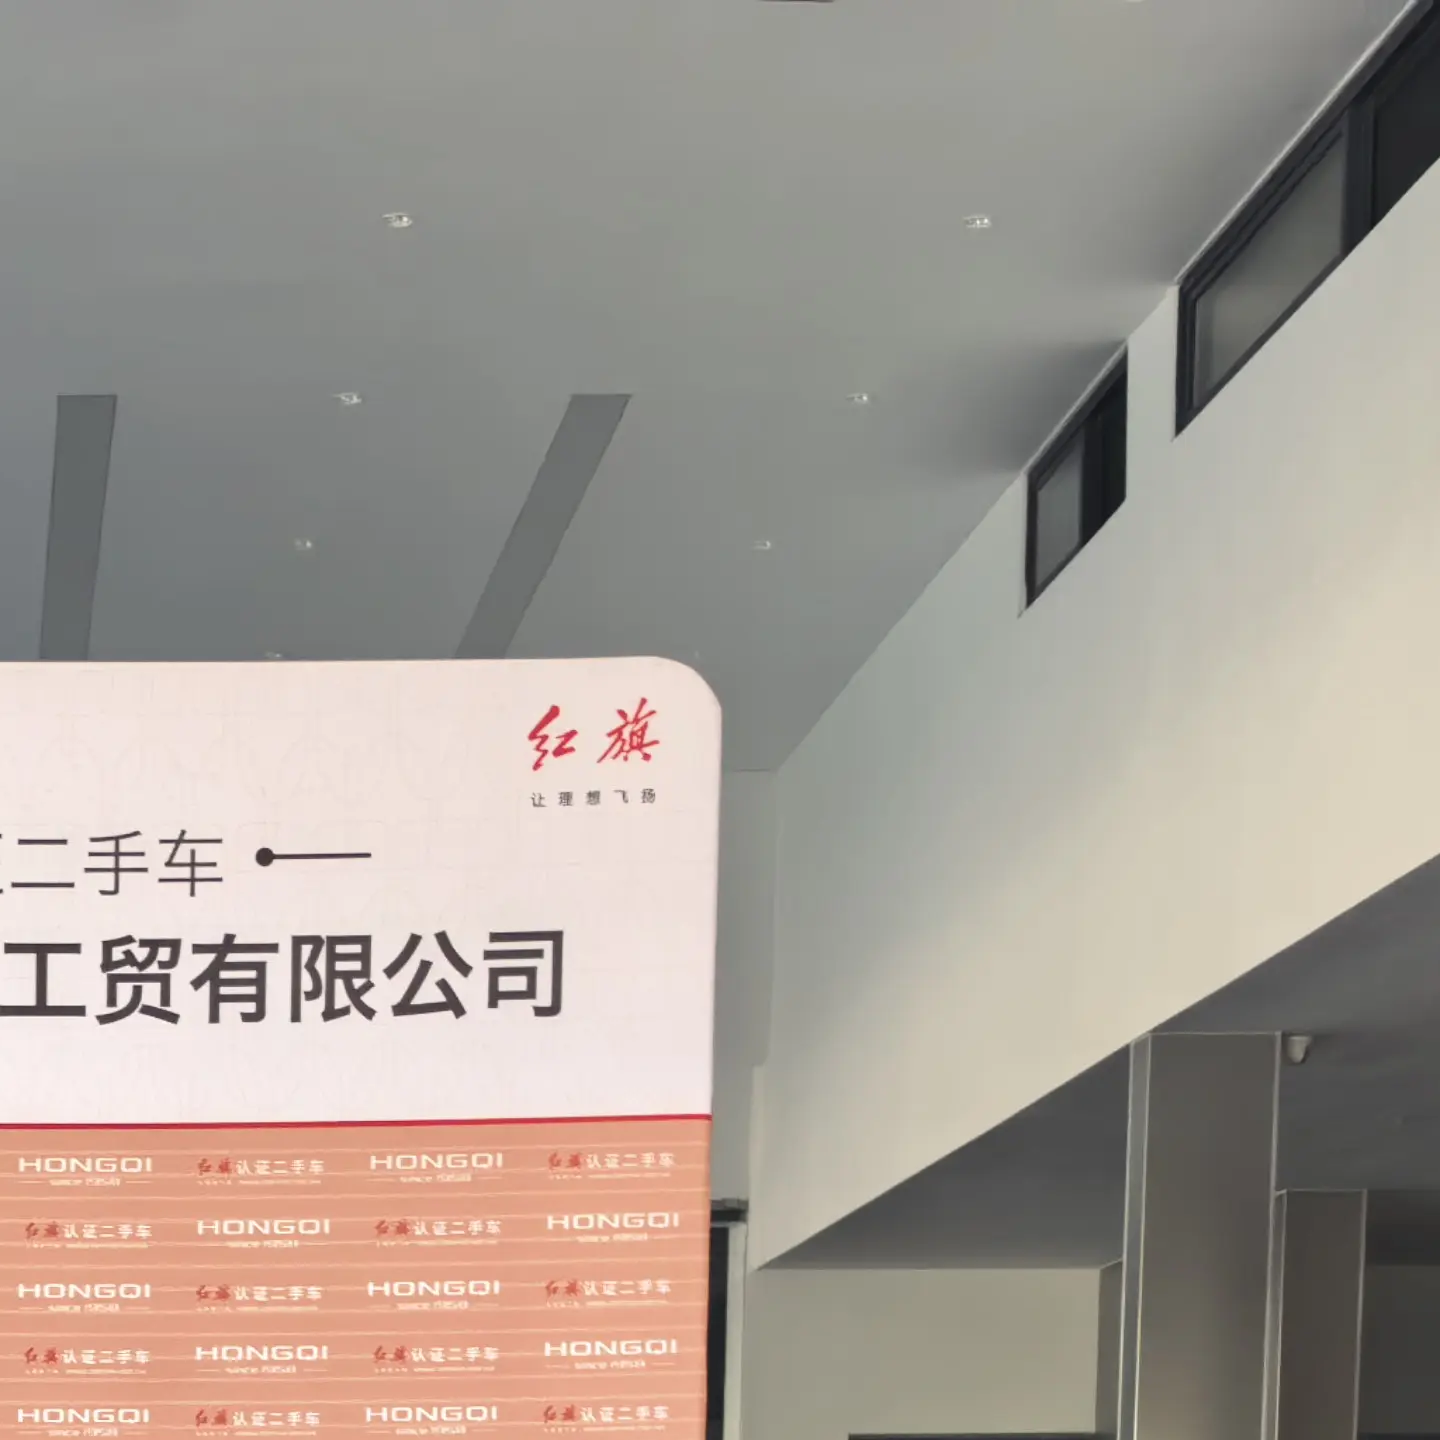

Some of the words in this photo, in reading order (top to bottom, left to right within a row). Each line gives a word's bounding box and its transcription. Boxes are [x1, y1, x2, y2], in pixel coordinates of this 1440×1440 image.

[527, 697, 661, 772] 红旗
[530, 787, 657, 809] 让理想飞扬
[19, 1157, 152, 1173] HONGQI
[370, 1153, 504, 1170] HONGQI
[197, 1219, 331, 1235] HONGQI
[547, 1212, 680, 1230] HONGQI
[17, 1283, 152, 1299] HONGQI
[367, 1280, 502, 1297] HONGQI
[194, 1345, 329, 1361] HONGQI
[544, 1339, 678, 1357] HONGQI
[17, 1408, 150, 1424] HONGQI
[366, 1406, 498, 1422] HONGQI
